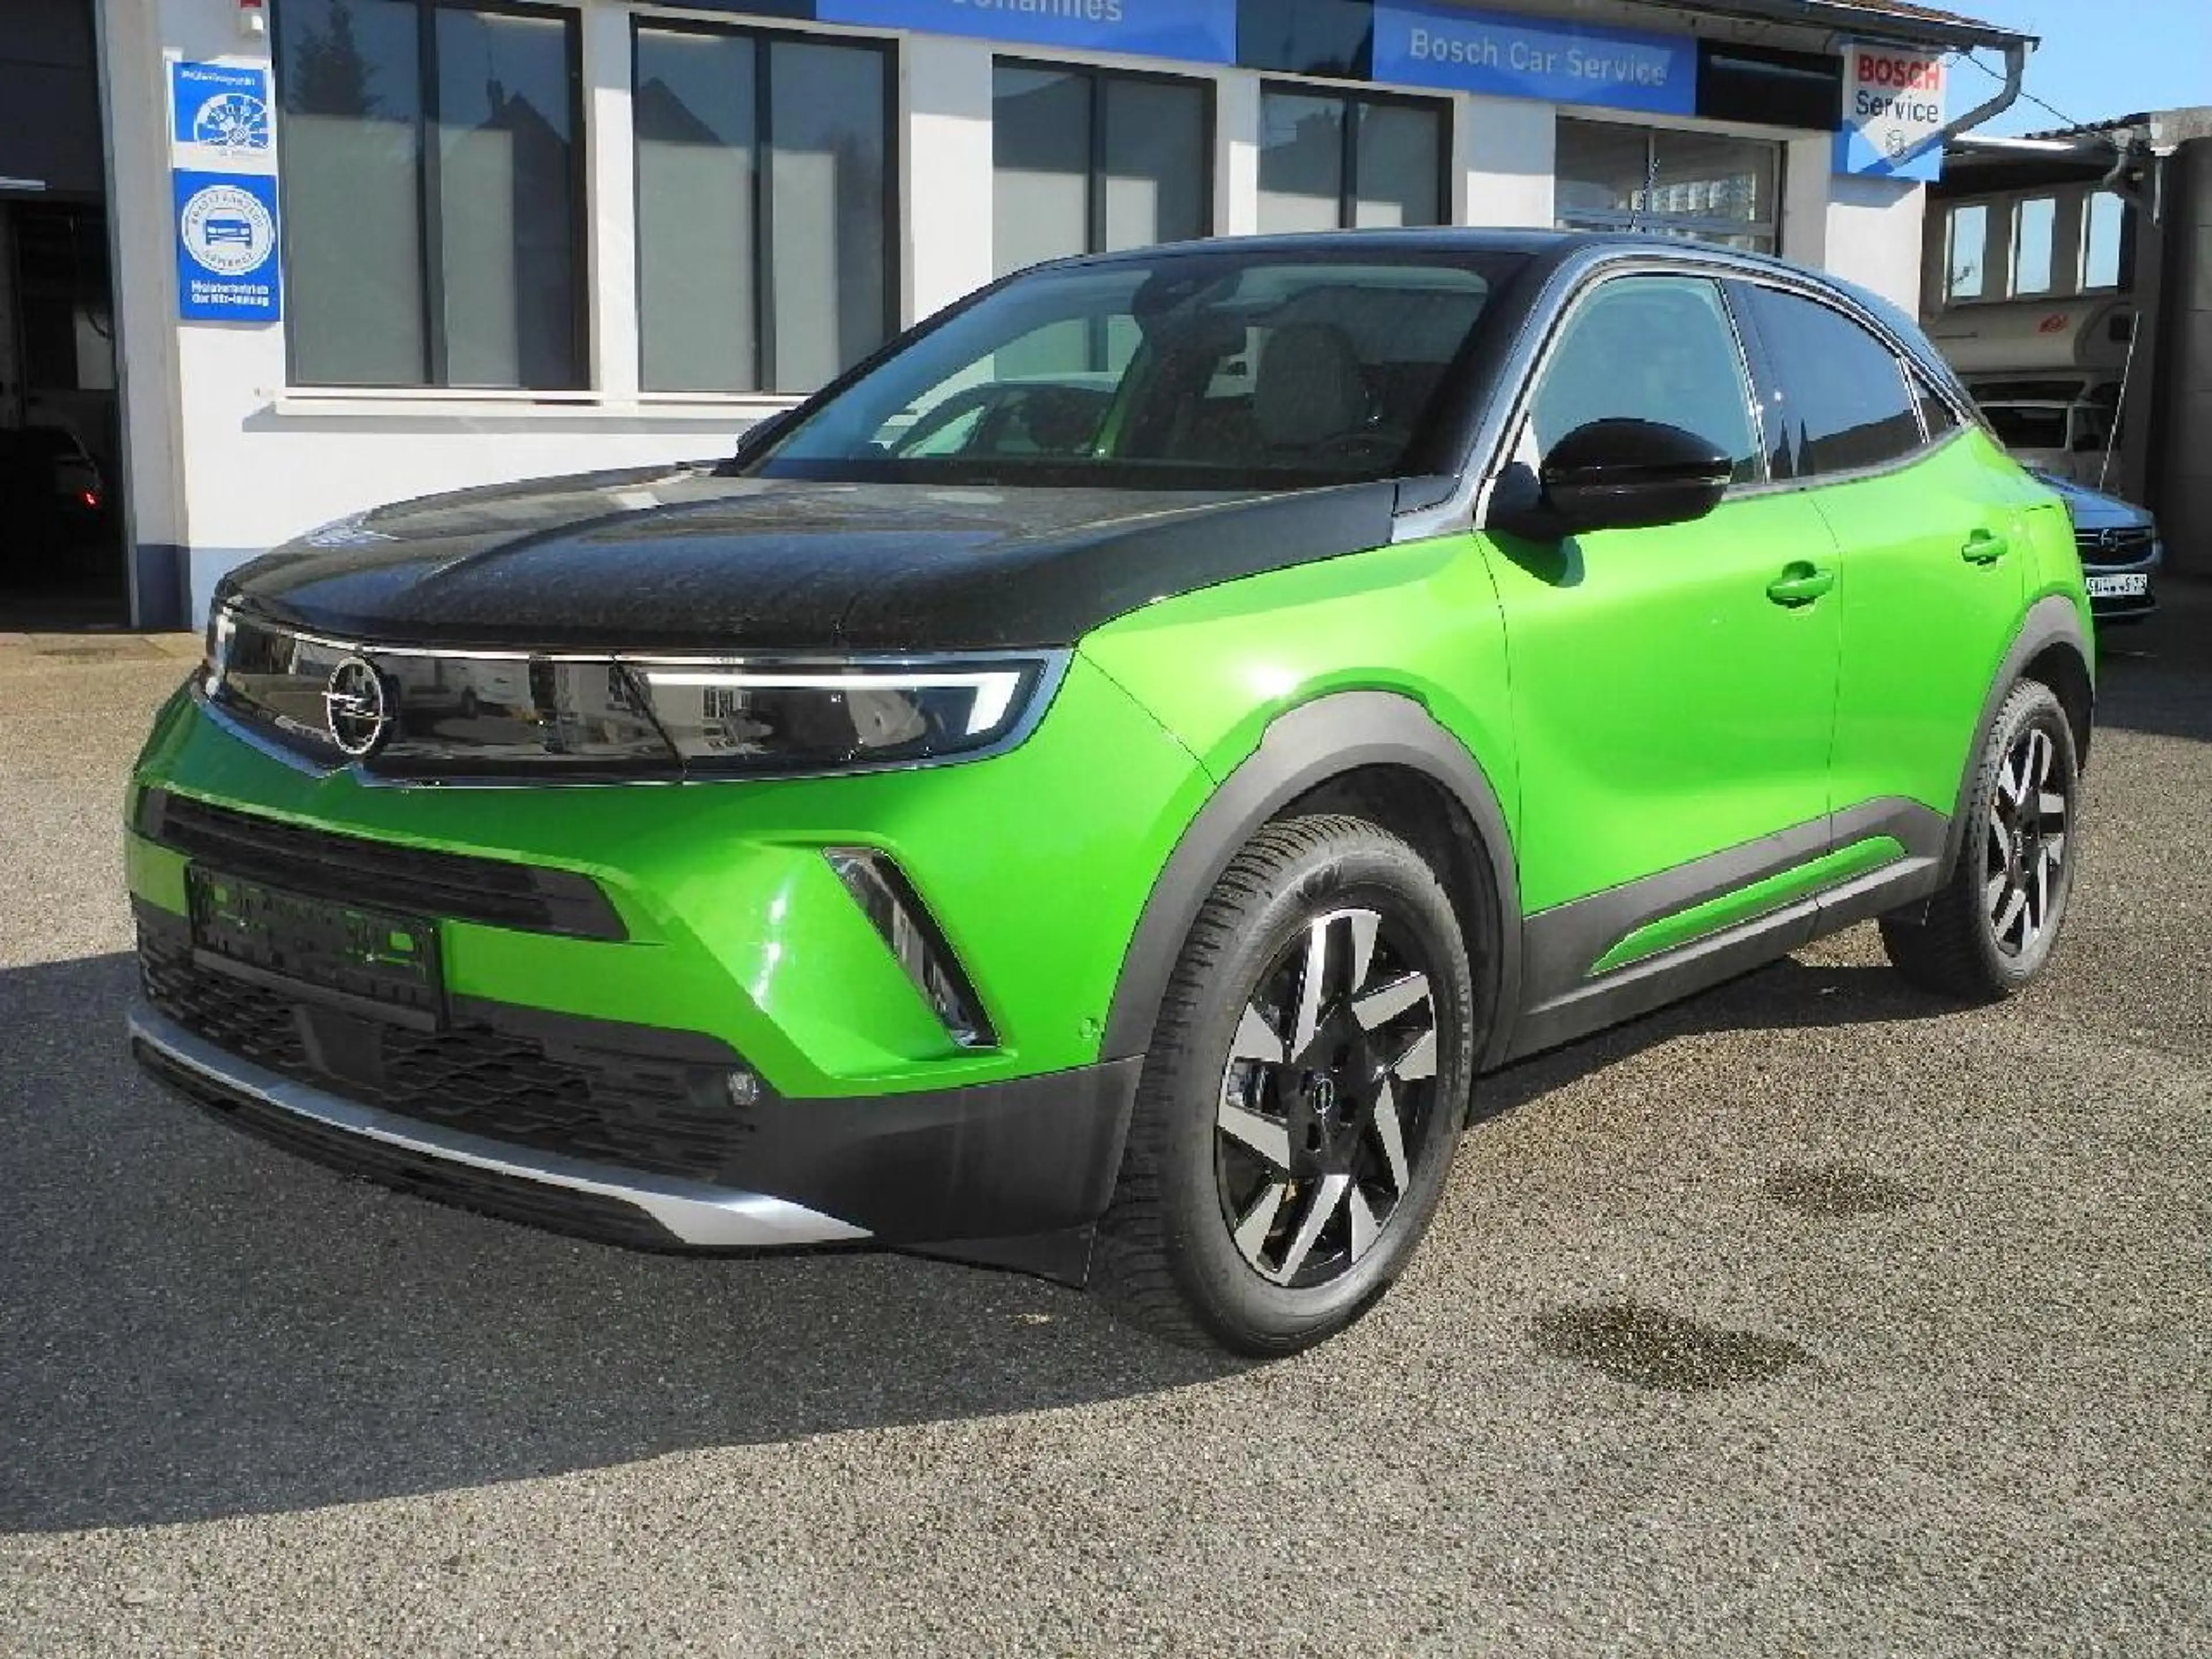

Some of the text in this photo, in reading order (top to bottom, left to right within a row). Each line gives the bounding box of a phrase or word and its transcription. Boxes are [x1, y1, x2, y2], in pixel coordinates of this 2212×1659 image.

[950, 0, 1122, 22] annes
[1410, 28, 1665, 86] Bosch Car Service
[1858, 54, 1940, 90] BOSCH
[1855, 90, 1938, 123] Service
